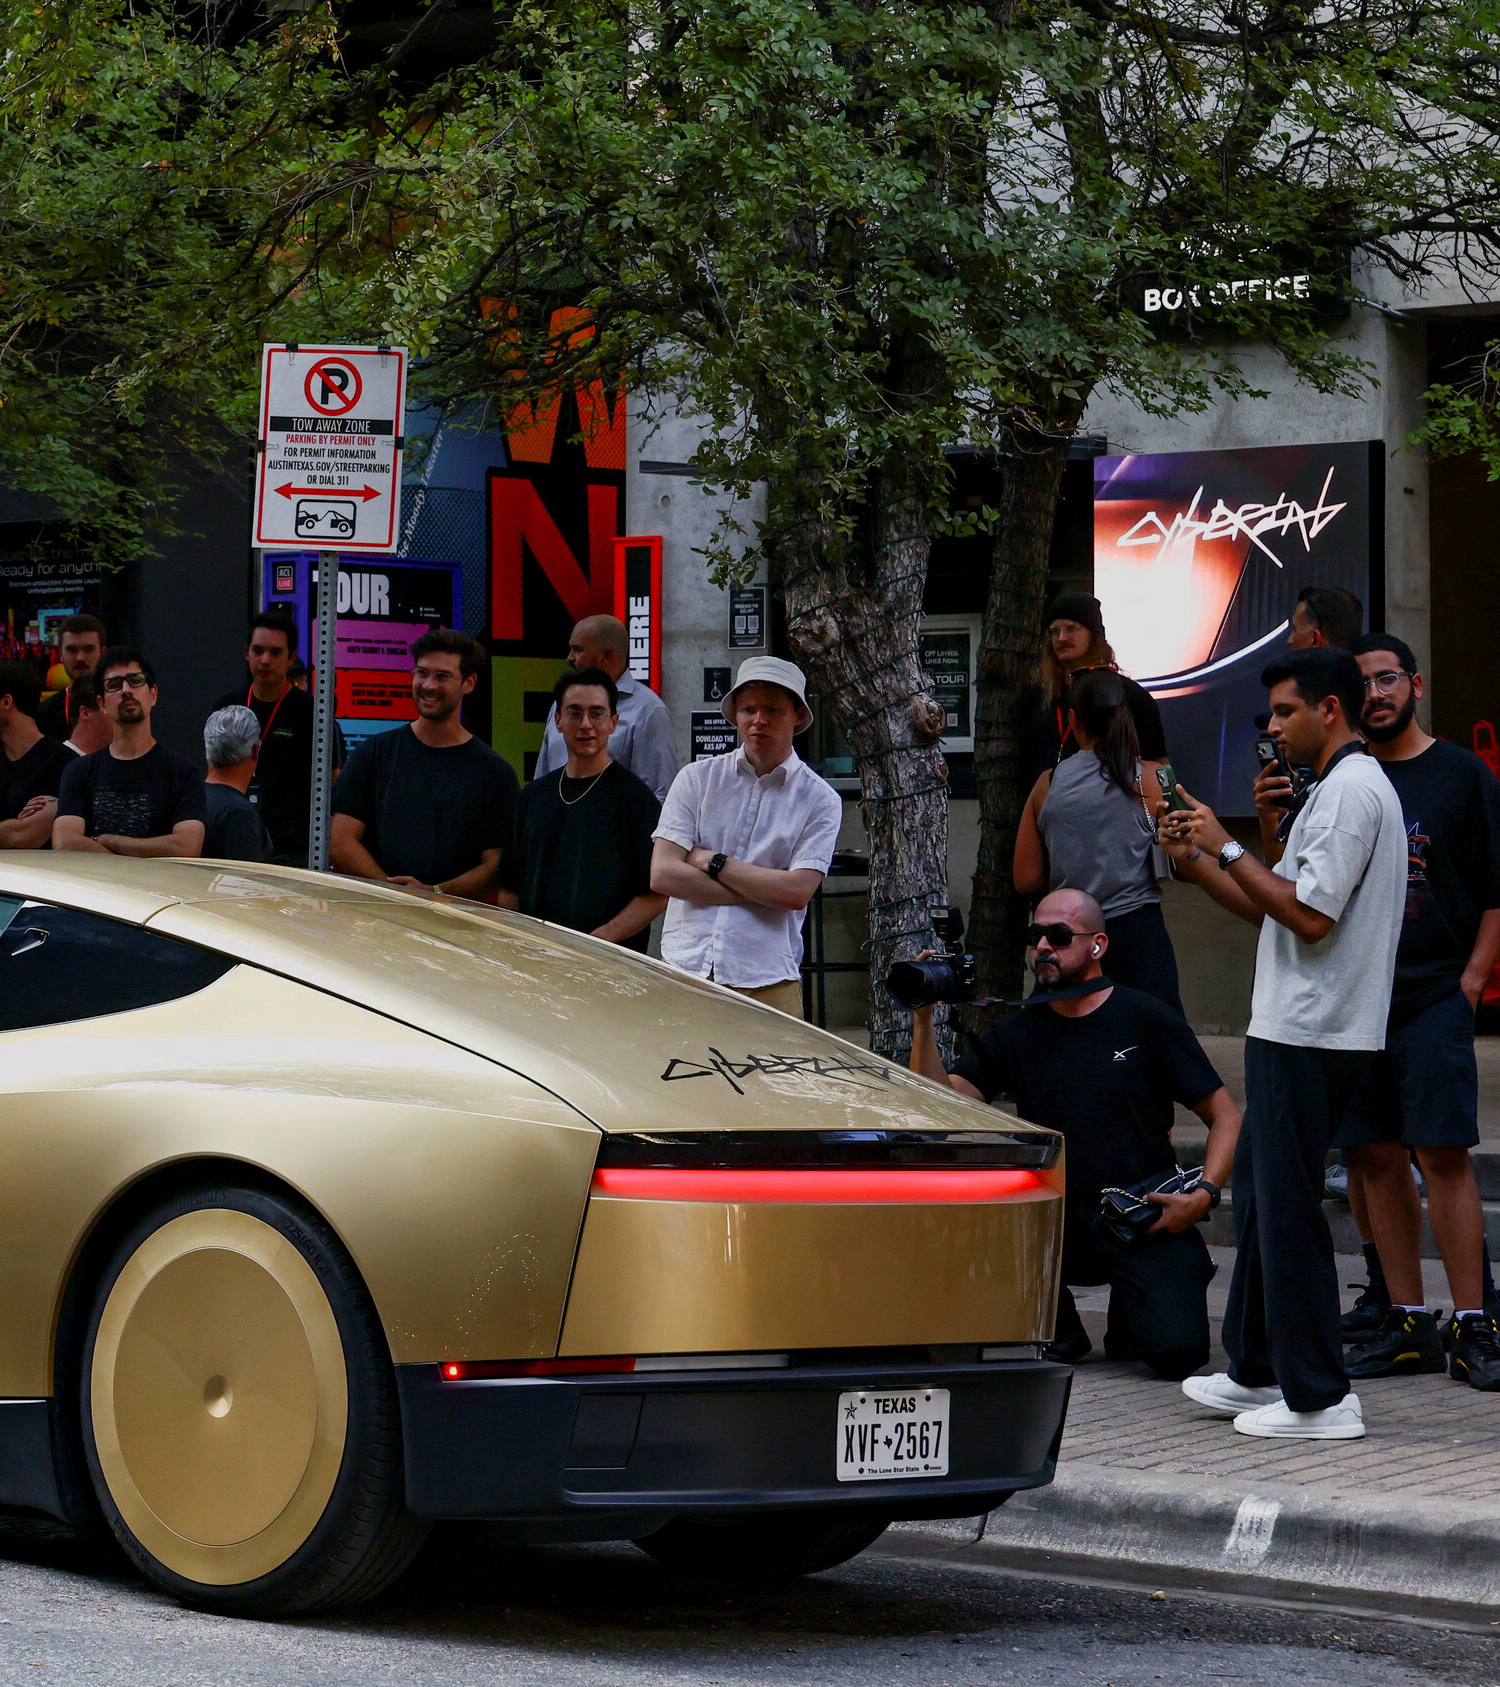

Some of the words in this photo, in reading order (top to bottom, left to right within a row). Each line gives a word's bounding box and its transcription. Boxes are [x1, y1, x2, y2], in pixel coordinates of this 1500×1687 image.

[292, 418, 313, 432] TOW
[316, 419, 342, 432] AWAY
[345, 420, 371, 433] ZONE
[286, 434, 316, 444] PARKING
[318, 435, 328, 445] BY
[329, 435, 355, 446] PERMIT
[357, 436, 376, 446] ONLY
[284, 447, 298, 457] FOR
[300, 448, 325, 458] PERMIT
[327, 449, 376, 460] INFORMATION
[268, 460, 391, 474] AUSTINTEXAS.GOV/STREETPARKING
[307, 475, 318, 485] OR
[319, 475, 335, 486] DIAL
[337, 476, 349, 486] 311
[37, 562, 56, 575] for
[278, 568, 291, 577] ACL
[312, 570, 390, 615] OUR
[629, 596, 650, 680] HERE
[935, 674, 965, 684] TOUR
[874, 1397, 916, 1415] TEXAS
